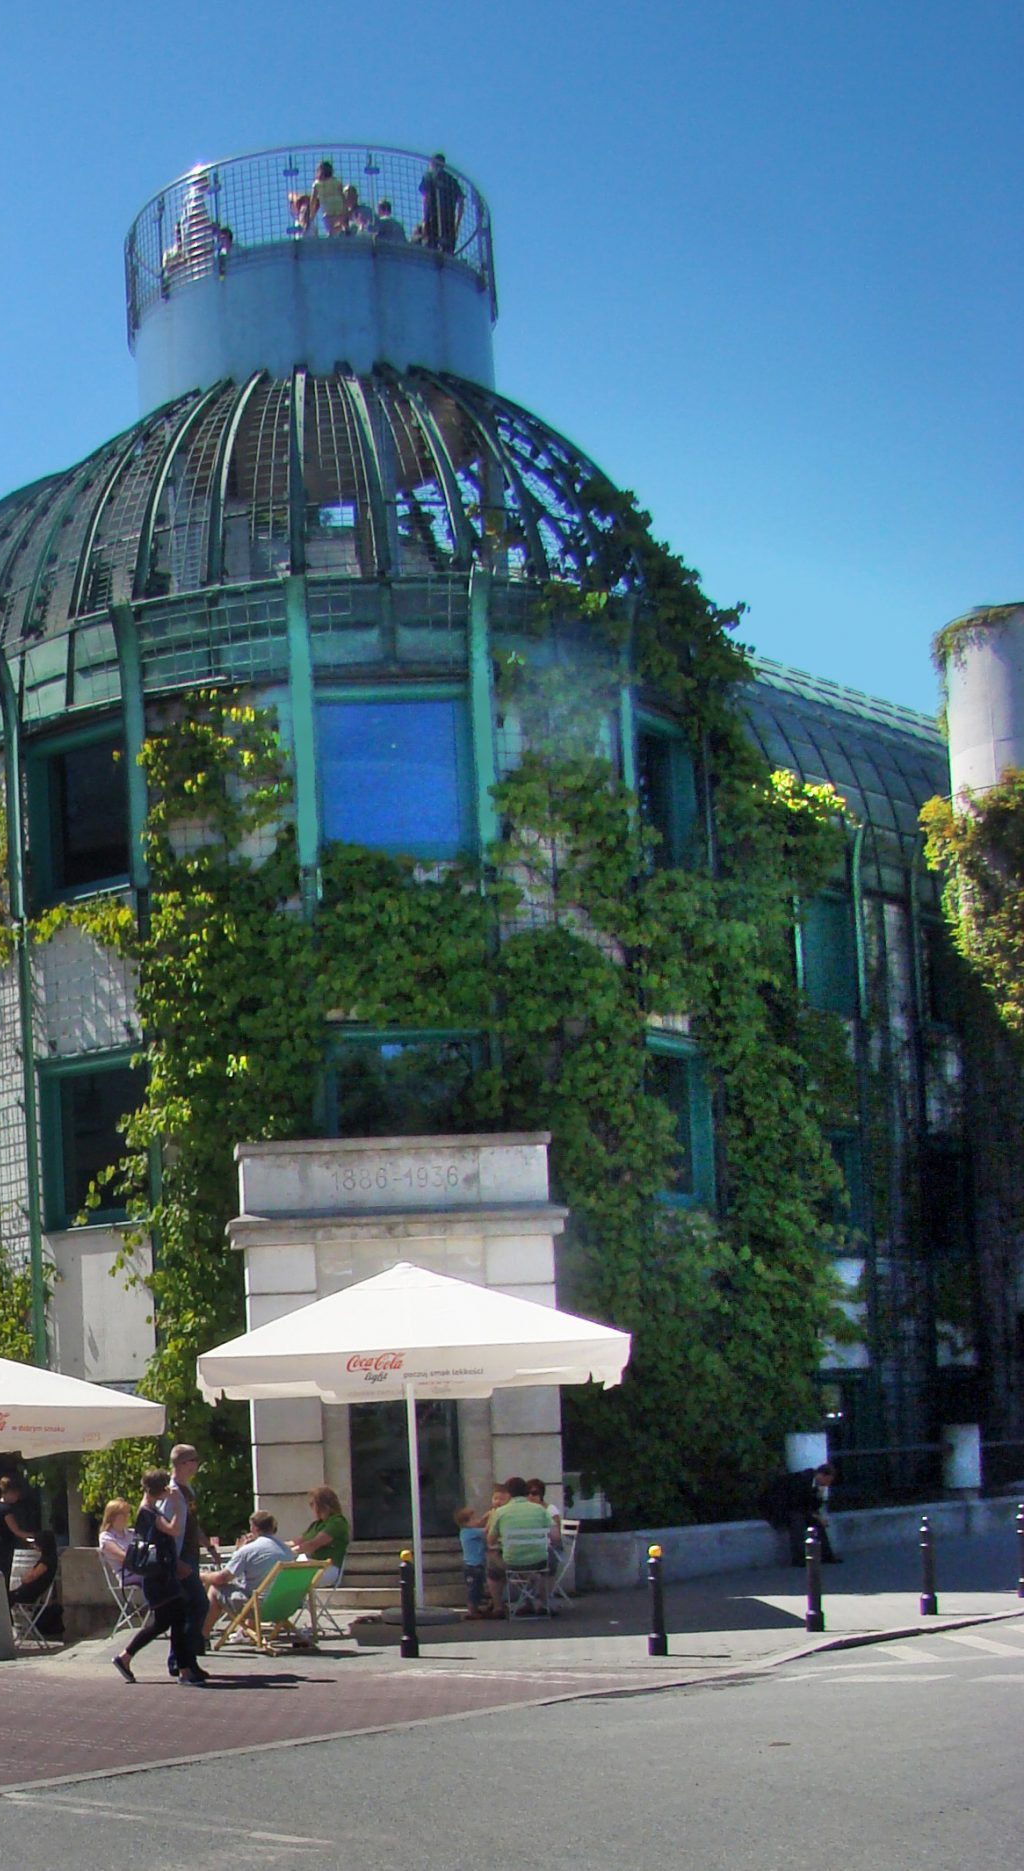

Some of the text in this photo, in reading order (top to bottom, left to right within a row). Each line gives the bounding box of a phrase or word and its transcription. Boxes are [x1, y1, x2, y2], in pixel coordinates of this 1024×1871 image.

[332, 1165, 458, 1191] 1886-1936
[346, 1351, 405, 1373] Coca-Cola
[364, 1371, 388, 1384] light
